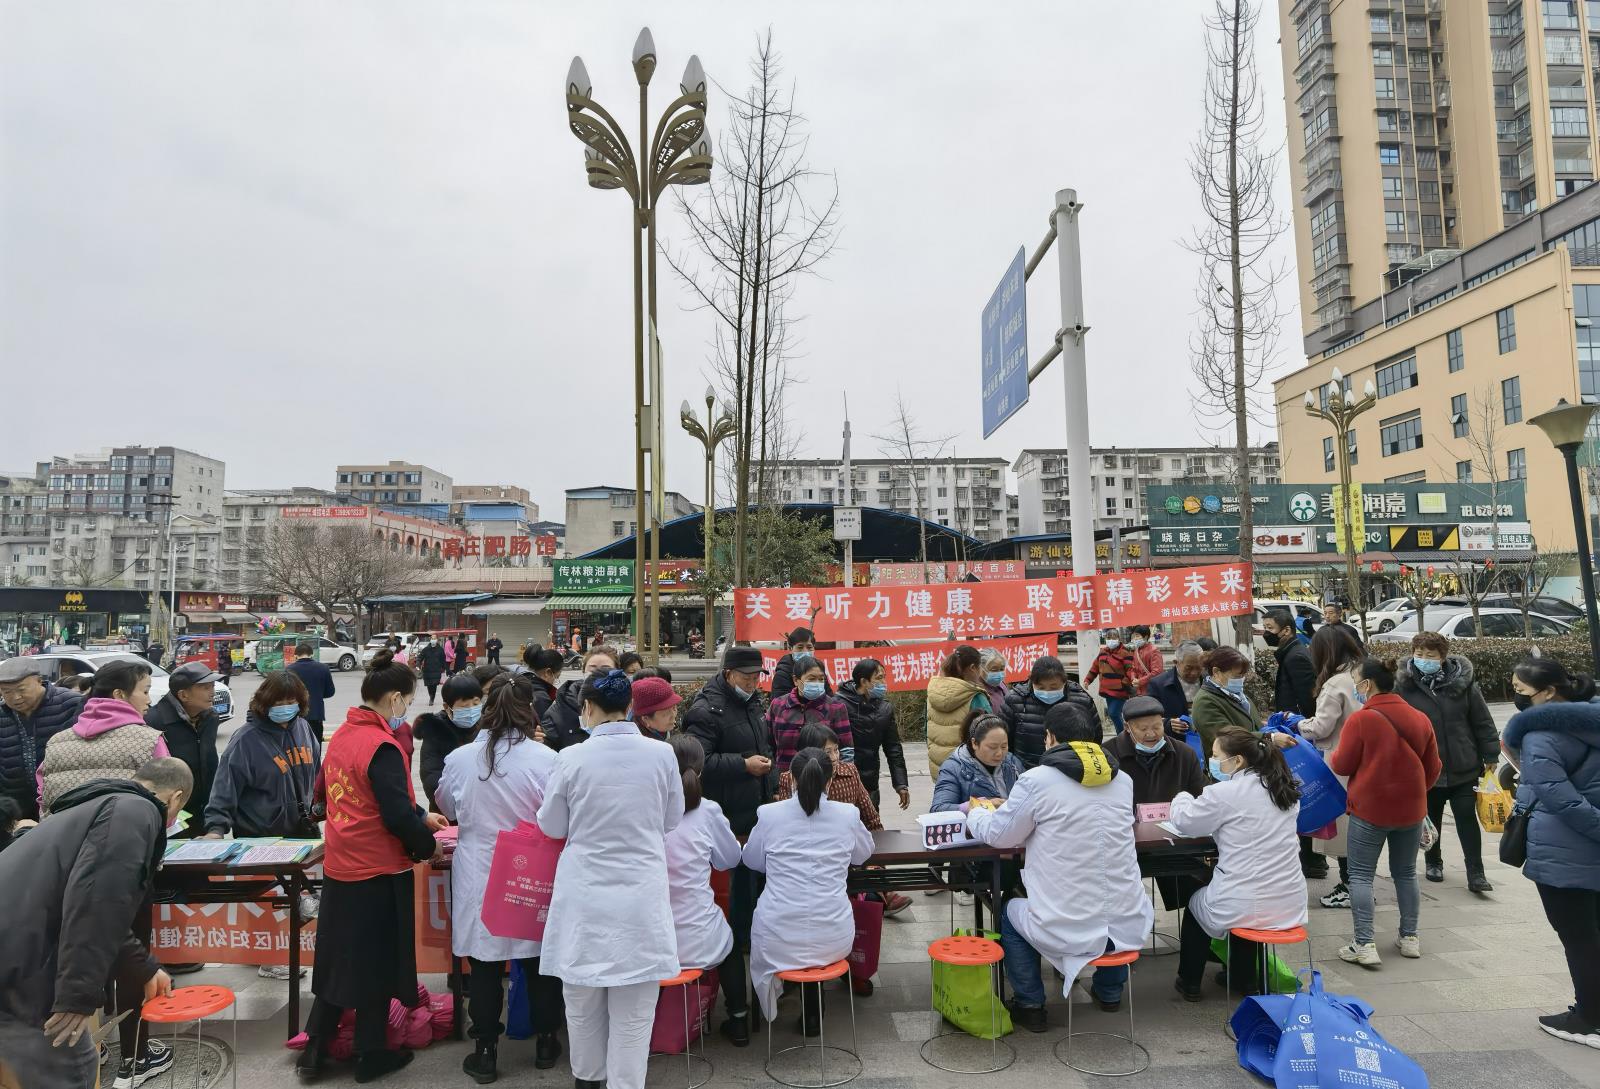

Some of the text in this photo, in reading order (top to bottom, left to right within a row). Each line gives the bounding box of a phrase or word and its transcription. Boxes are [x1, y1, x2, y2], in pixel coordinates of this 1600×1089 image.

[1321, 492, 1407, 513] 美润嘉
[1161, 531, 1223, 542] 晓晓日杂
[558, 565, 629, 577] 传林粮油副食
[745, 567, 1246, 621] 关爱听力健康 聆听精彩未来
[1160, 600, 1249, 618] 游仙区残疾人联合会
